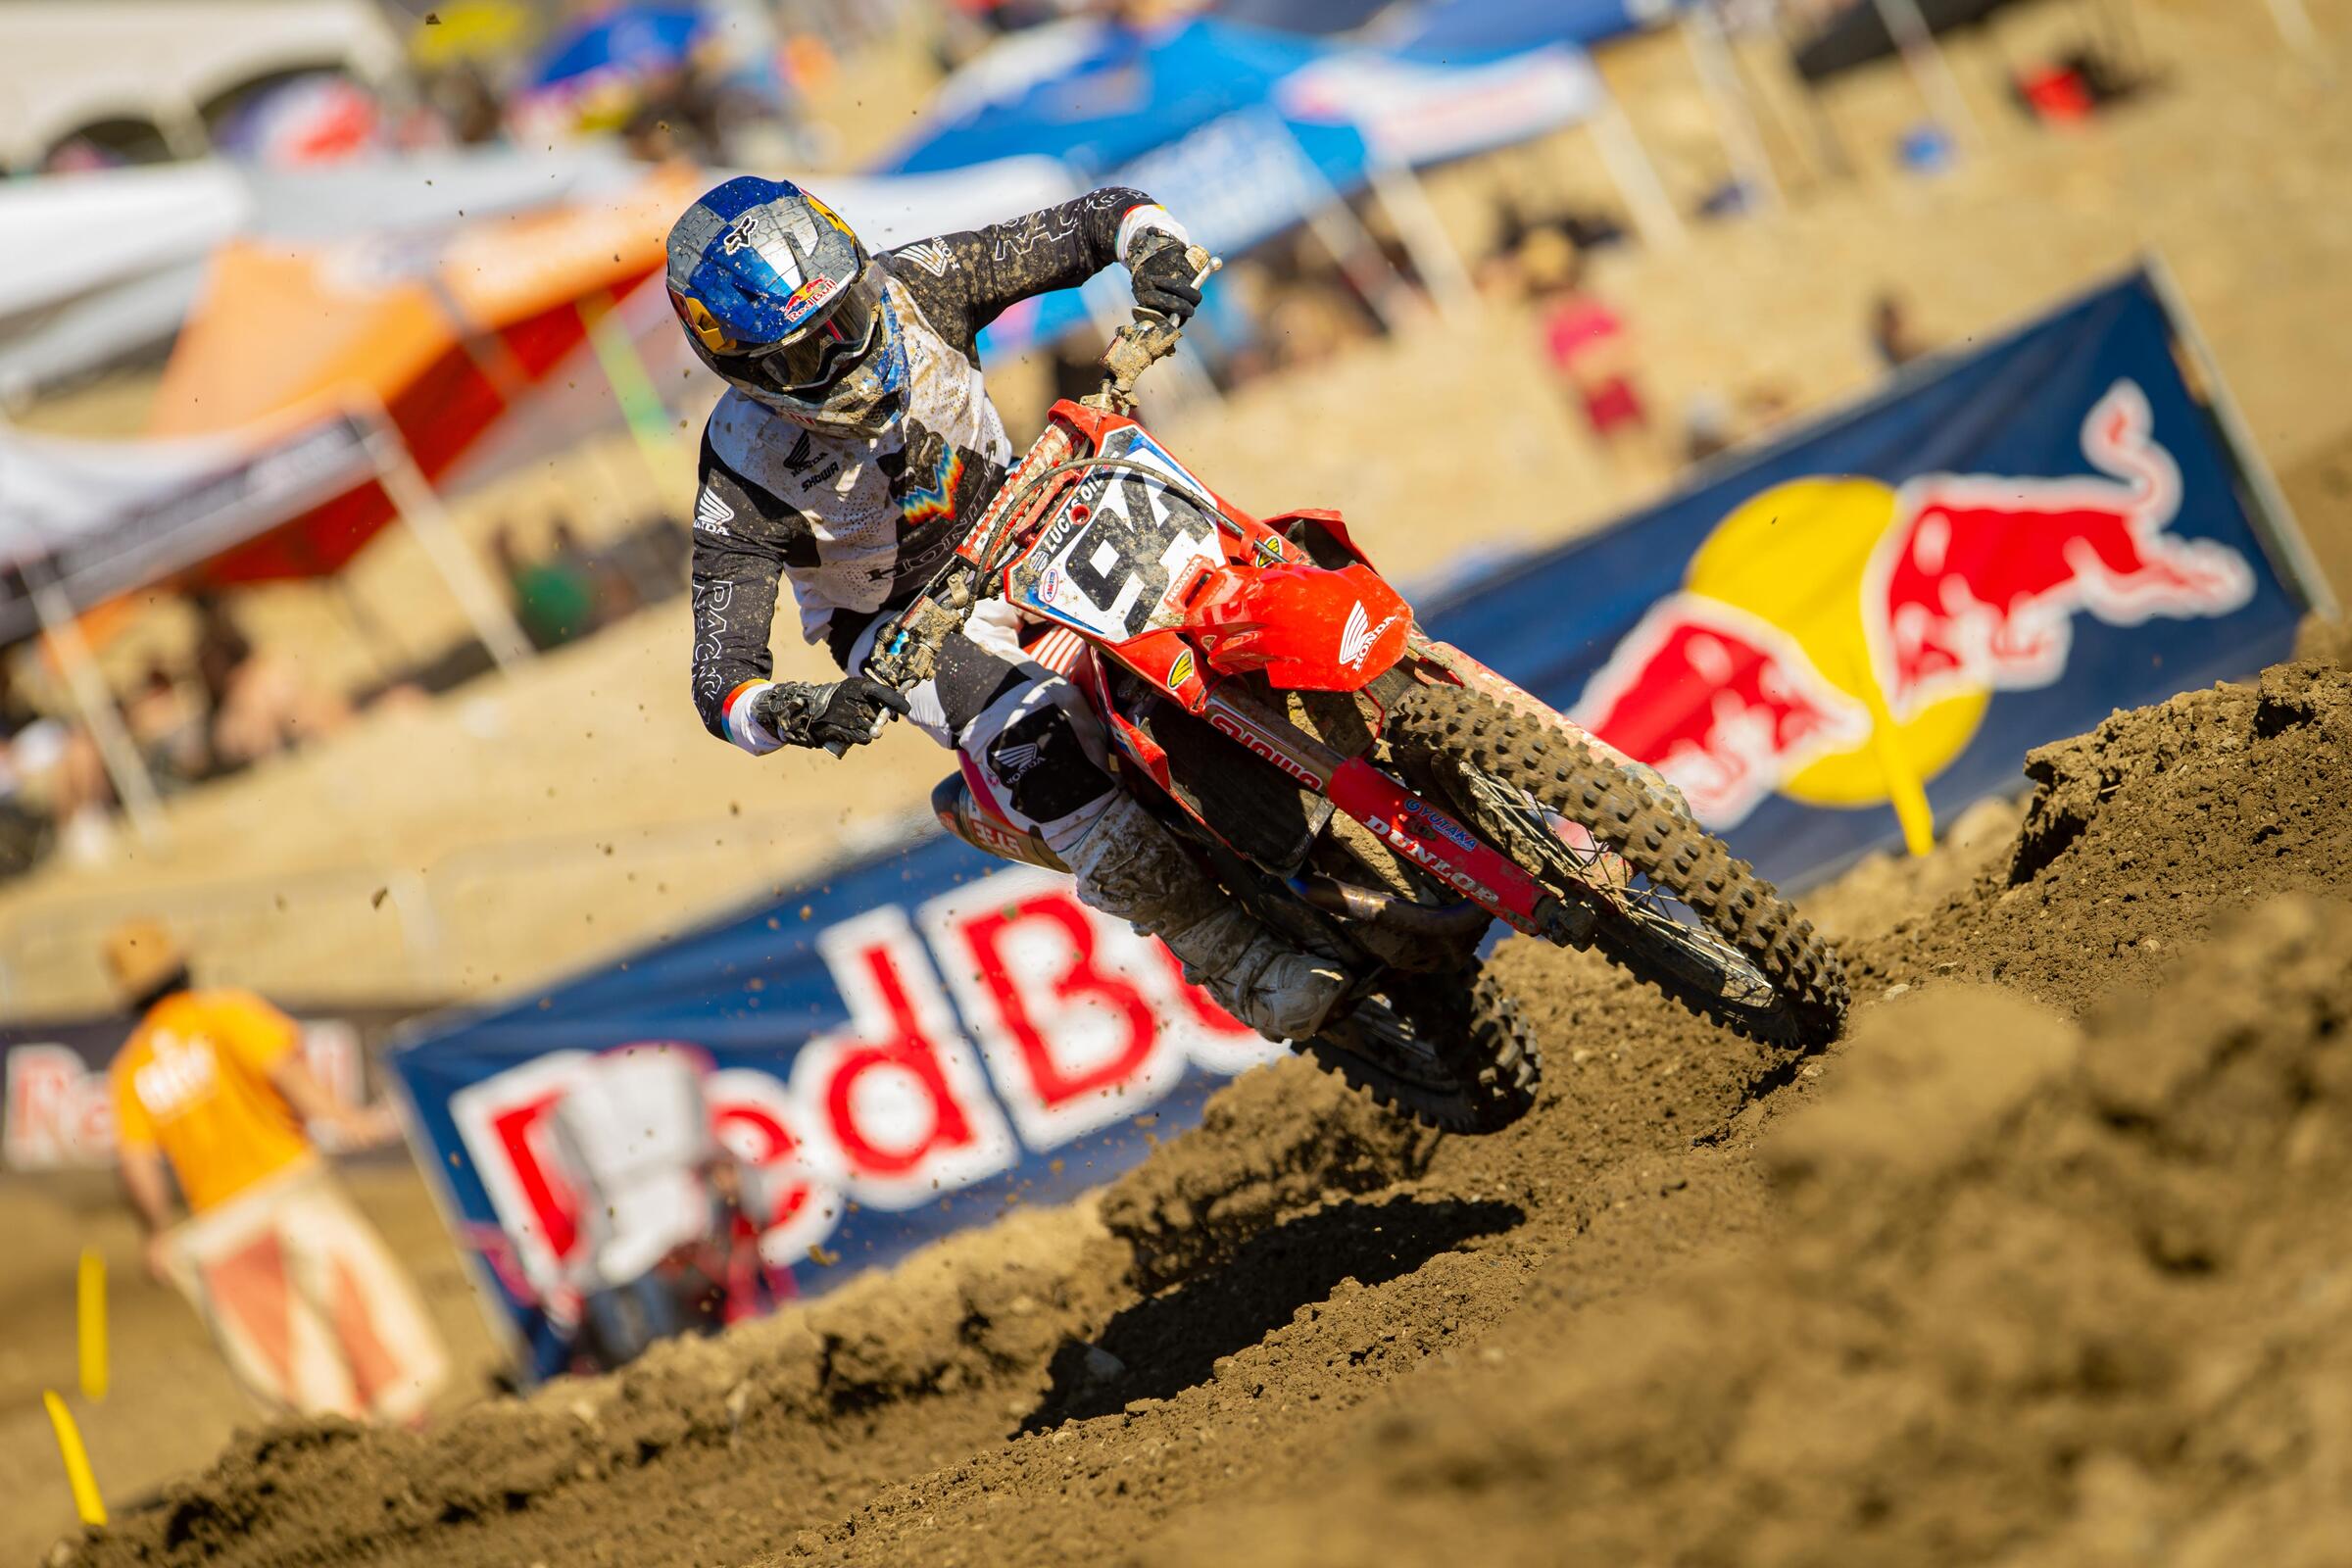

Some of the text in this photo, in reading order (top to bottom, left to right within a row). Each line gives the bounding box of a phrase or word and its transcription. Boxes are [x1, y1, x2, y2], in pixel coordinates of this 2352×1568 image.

[801, 462, 840, 493] SHOWA
[1080, 472, 1105, 503] OIL
[1065, 466, 1214, 637] 94
[1167, 558, 1201, 604] HONDA
[1351, 614, 1397, 673] HONDA
[1363, 814, 1500, 905] DUNLOP
